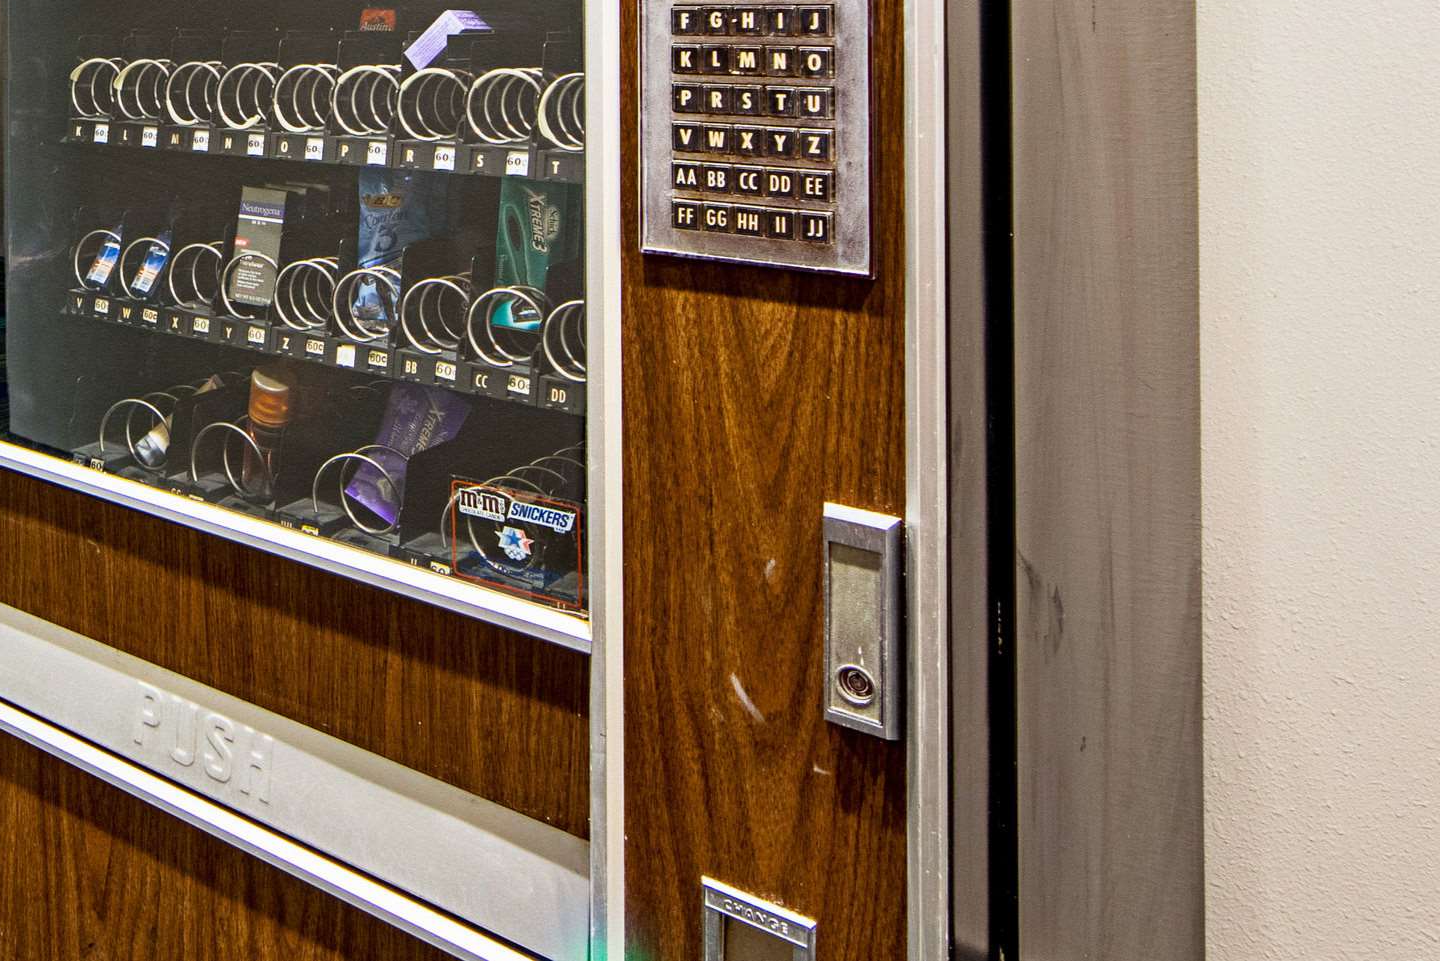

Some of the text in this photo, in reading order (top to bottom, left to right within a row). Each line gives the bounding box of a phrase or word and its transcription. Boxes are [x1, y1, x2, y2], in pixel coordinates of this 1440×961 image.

[680, 12, 820, 30] F G H I J
[680, 51, 822, 71] K L M N O
[680, 89, 820, 113] P R S T U
[76, 126, 82, 137] K
[123, 129, 127, 140] L
[171, 133, 179, 144] M
[680, 128, 820, 154] V W X Y Z
[341, 144, 349, 157] P
[406, 149, 414, 162] R
[476, 155, 484, 168] S
[551, 161, 560, 174] T
[676, 169, 823, 196] AA BB CC DD EE
[241, 203, 281, 216] Neutrogena
[678, 207, 824, 237] FF GG HH II JJ
[76, 297, 82, 308] V
[122, 307, 131, 319] W
[172, 317, 178, 328] X
[226, 327, 233, 339] Y
[282, 337, 289, 350] Z
[405, 360, 418, 374] BB
[475, 374, 488, 388] CC
[551, 388, 566, 403] DD
[511, 502, 570, 528] SNICKERS
[133, 681, 274, 806] PUSH
[723, 899, 790, 935] CHANGE
